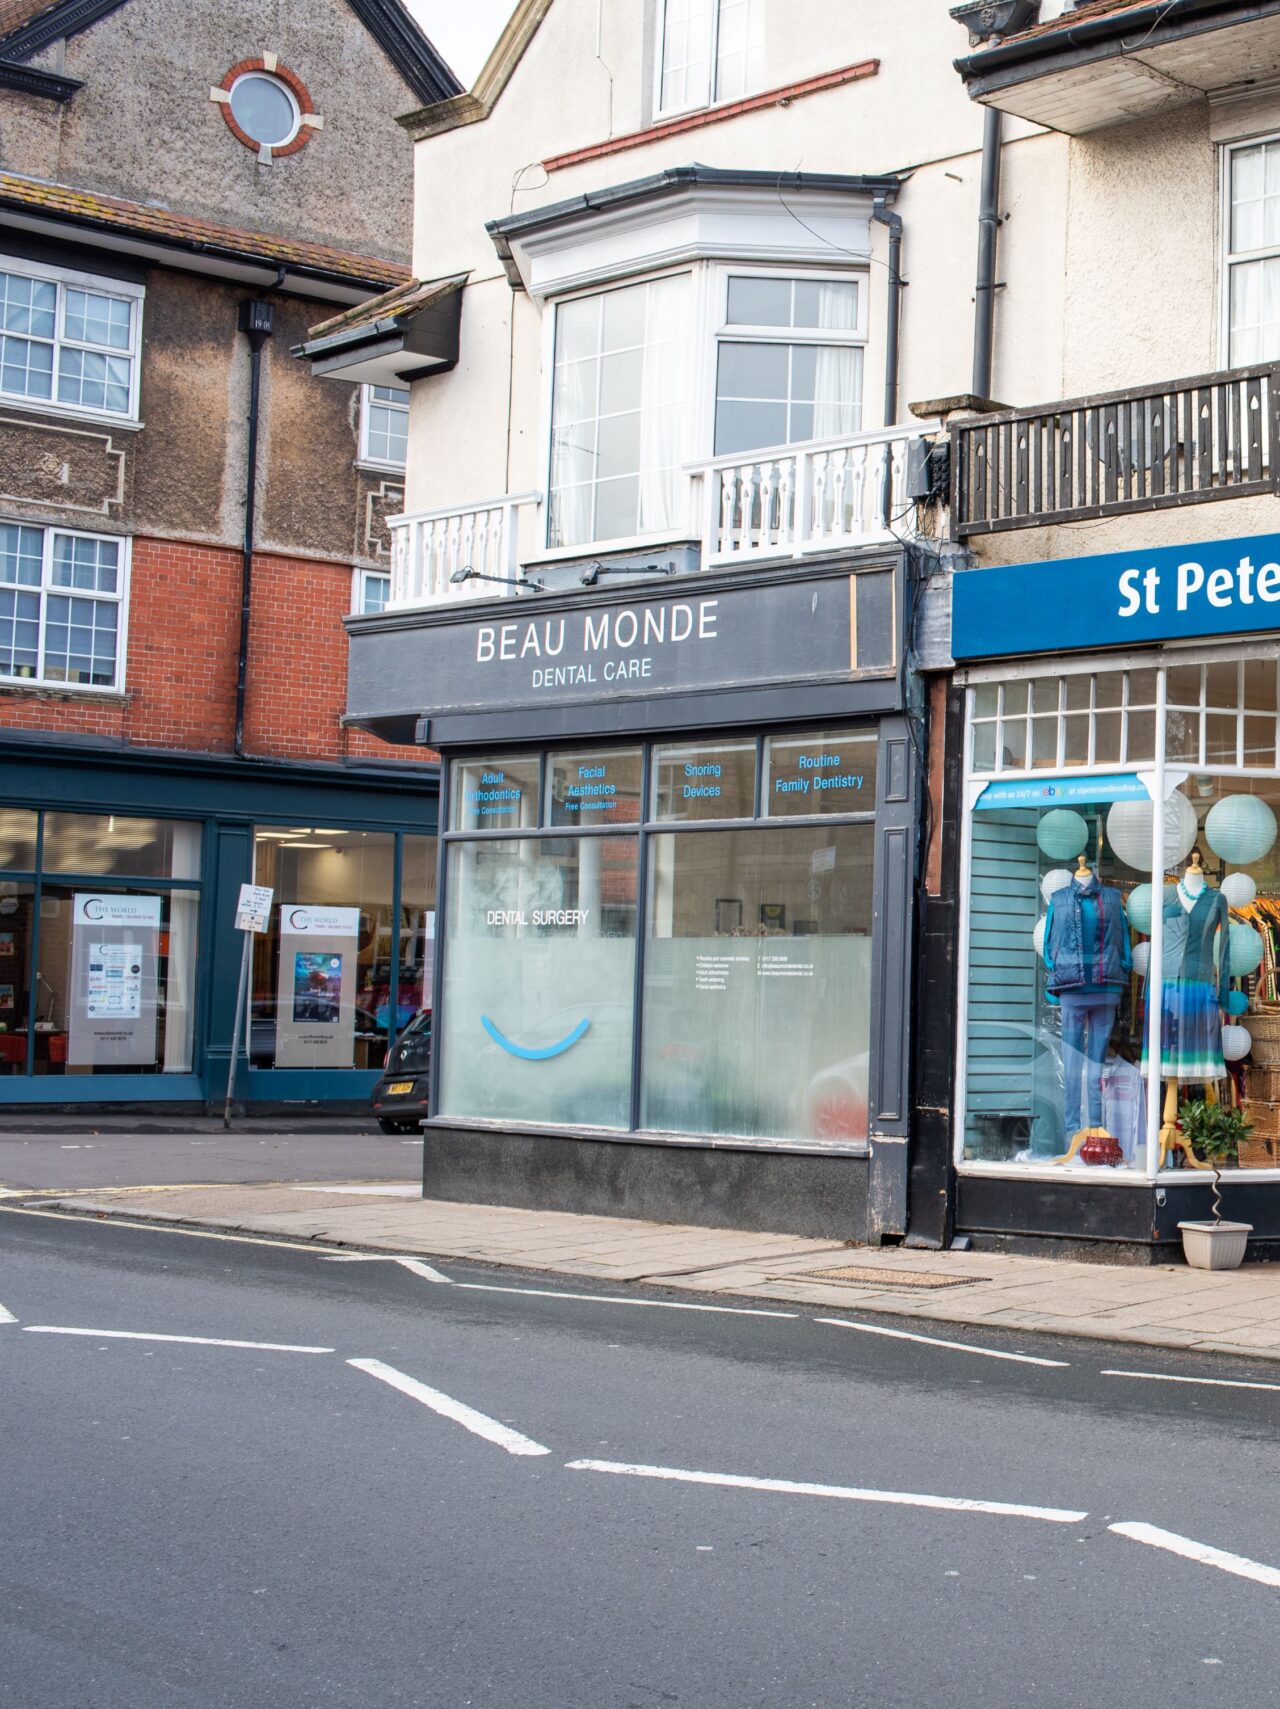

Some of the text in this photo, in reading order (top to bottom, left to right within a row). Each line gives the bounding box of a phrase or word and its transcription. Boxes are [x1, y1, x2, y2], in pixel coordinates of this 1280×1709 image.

[1117, 567, 1161, 617] St
[476, 600, 719, 663] BEAU MONDE
[532, 658, 652, 688] DENTAL CARE
[798, 754, 841, 769] Routine
[578, 766, 606, 779] Facial
[684, 763, 721, 777] Snoring
[481, 771, 505, 785] Adult
[775, 775, 864, 793] Family Dentistry
[567, 784, 616, 797] Aesthetics
[683, 785, 721, 798] Devices
[565, 801, 617, 811] Free Consultation
[95, 905, 108, 913] THE
[110, 906, 137, 914] WORLD
[314, 916, 339, 924] WORLD
[486, 909, 589, 925] DENTAL SURGERY
